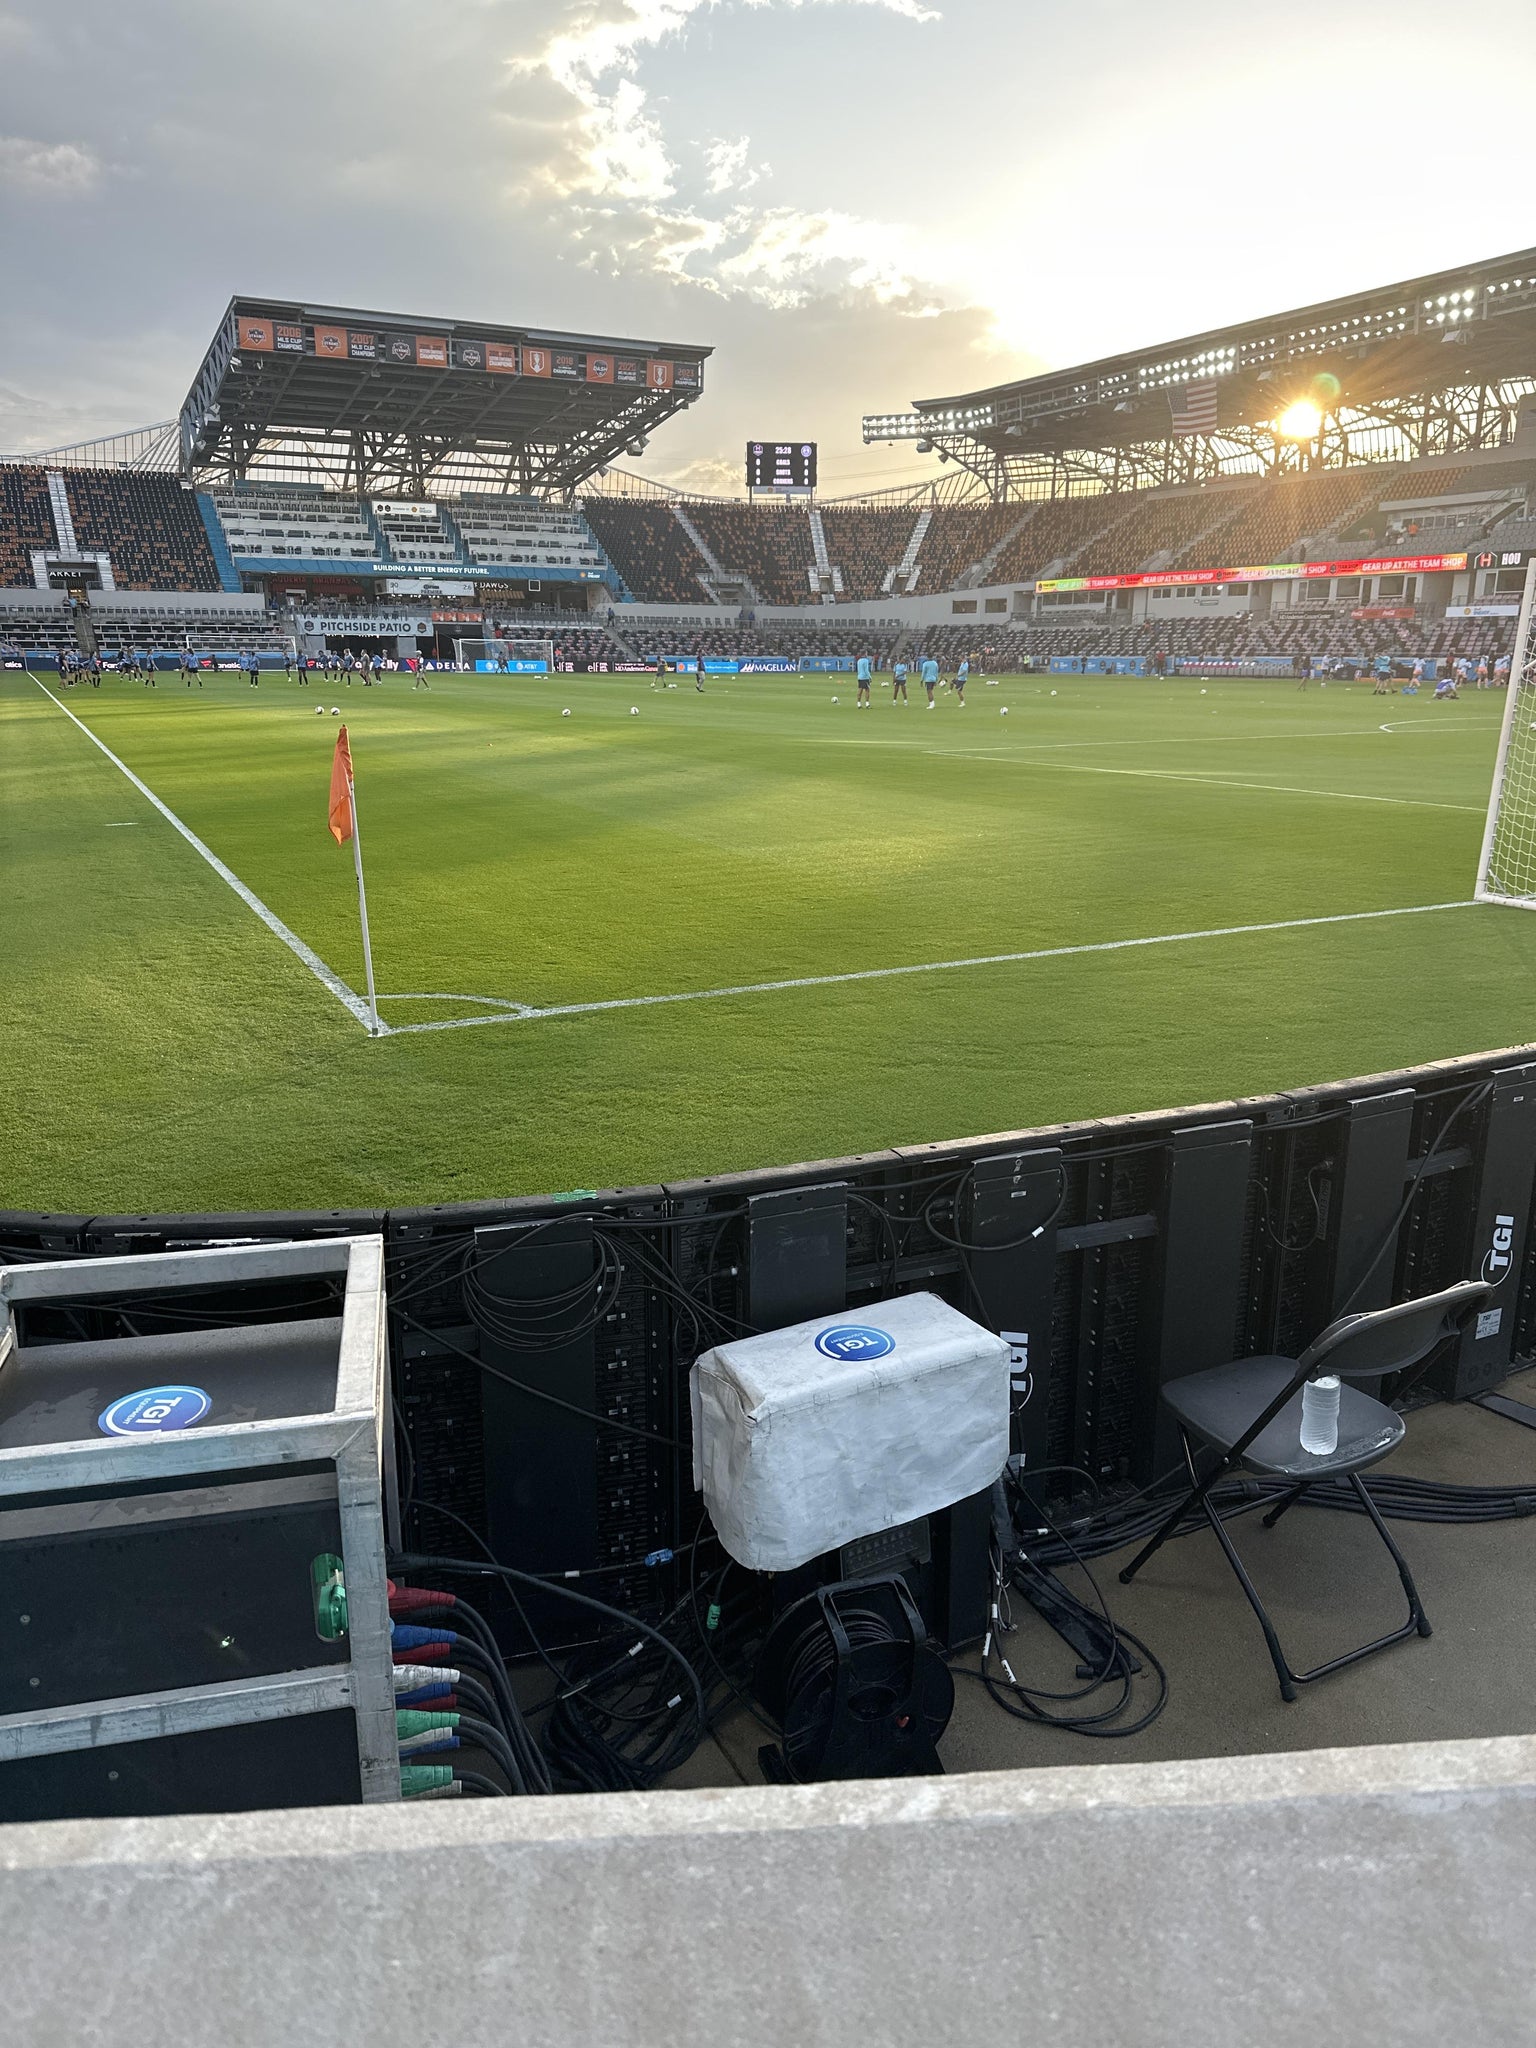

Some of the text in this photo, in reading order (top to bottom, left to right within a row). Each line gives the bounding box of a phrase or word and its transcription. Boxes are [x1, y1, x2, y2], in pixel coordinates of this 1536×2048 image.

[277, 326, 301, 337] 2006
[351, 334, 374, 345] 2007
[556, 356, 574, 364] 2018
[1362, 557, 1463, 571] GEAR UP AT THE TEAM SHOP
[1502, 553, 1521, 565] HOU
[321, 622, 411, 632] PITCHSIDE PATIO
[436, 662, 470, 670] DELTA
[588, 662, 599, 672] elf
[1489, 1215, 1514, 1271] TGI
[836, 1336, 879, 1352] TGI
[122, 1398, 152, 1424] EQUIPMENT
[135, 1397, 183, 1424] TGI
